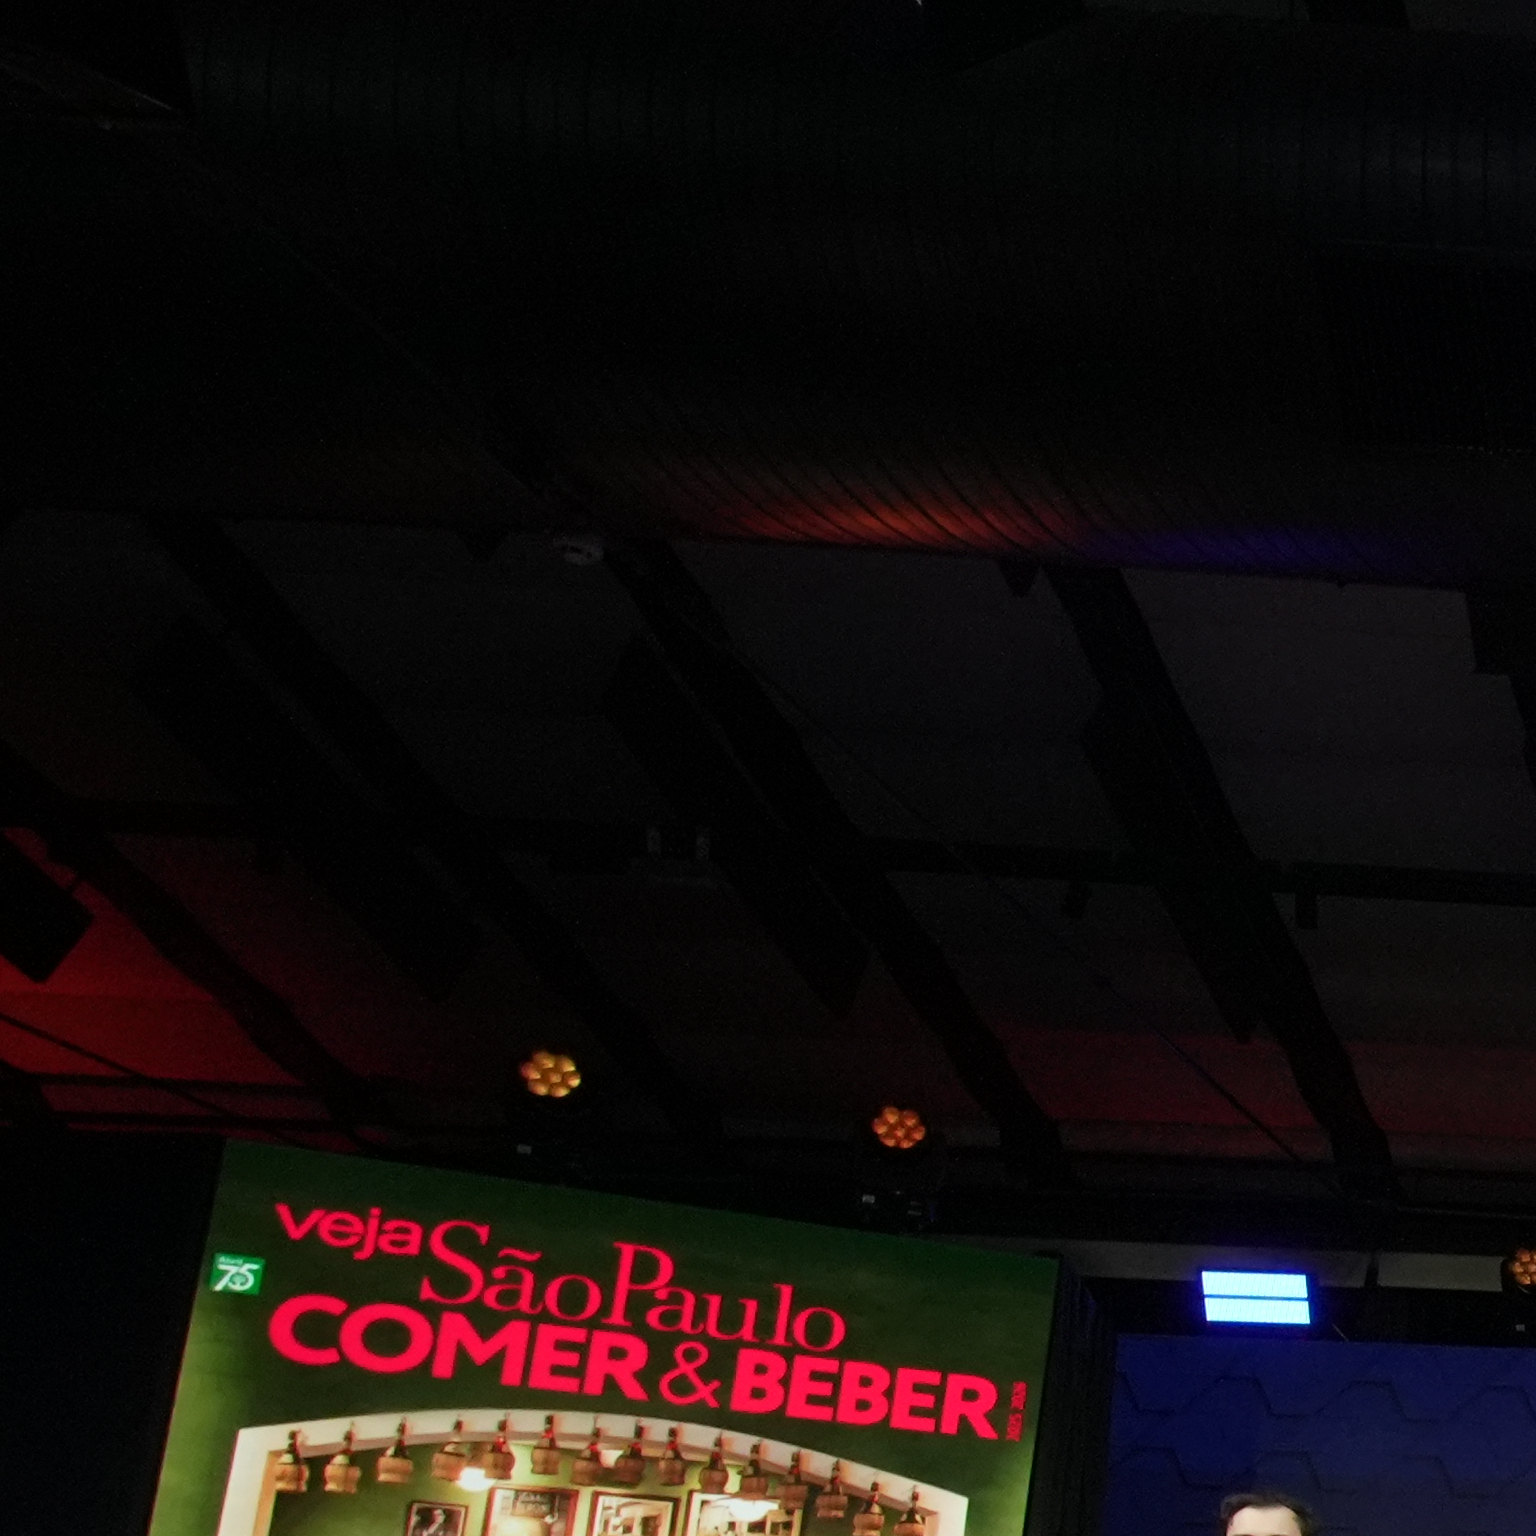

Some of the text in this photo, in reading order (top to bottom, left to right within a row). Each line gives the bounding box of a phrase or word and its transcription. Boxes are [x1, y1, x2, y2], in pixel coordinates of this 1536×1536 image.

[275, 1203, 425, 1260] veja
[268, 1294, 649, 1402] COMER
[658, 1341, 720, 1408] &
[729, 1348, 999, 1440] BEBER
